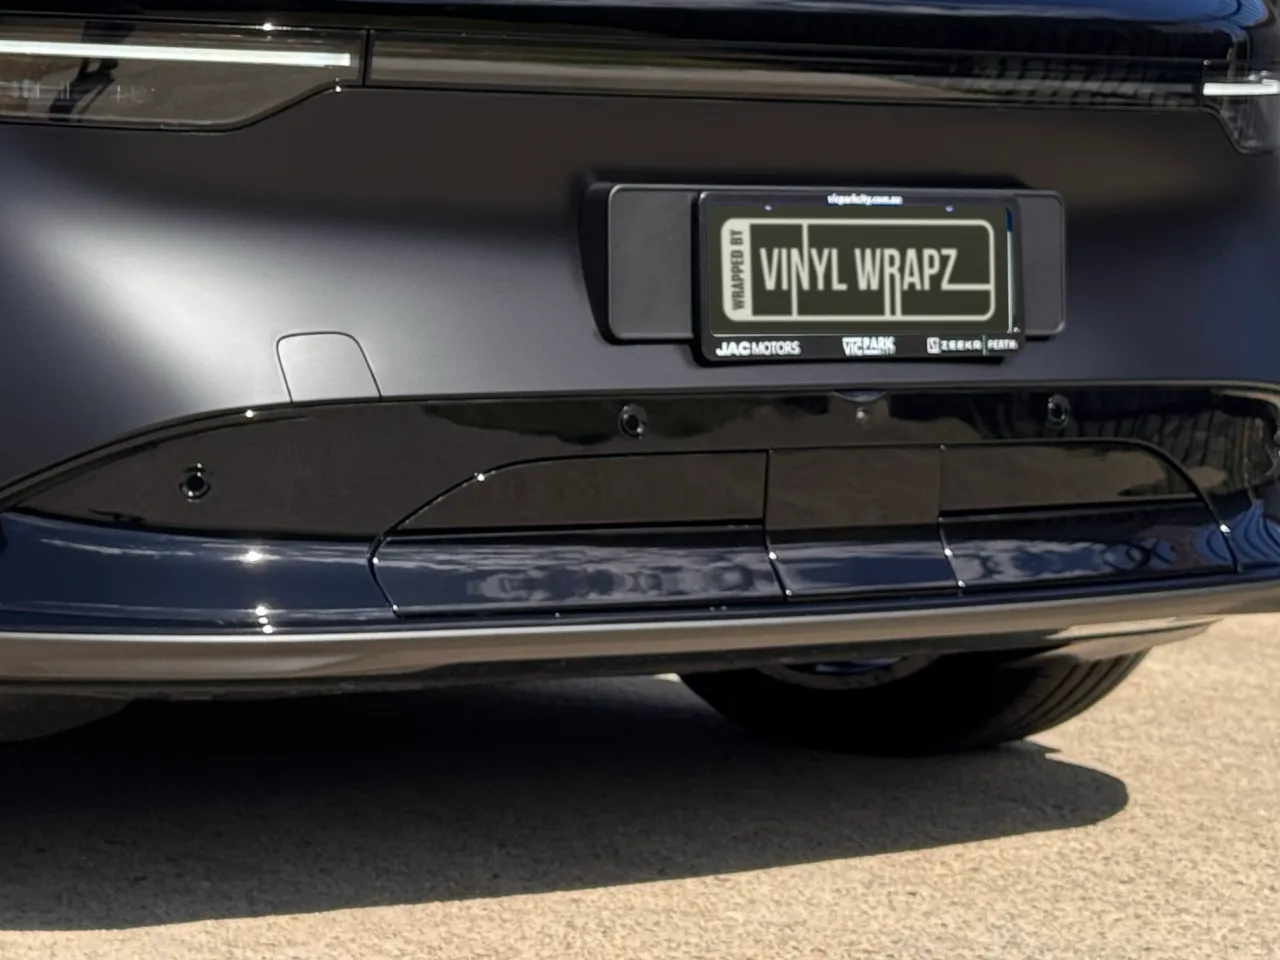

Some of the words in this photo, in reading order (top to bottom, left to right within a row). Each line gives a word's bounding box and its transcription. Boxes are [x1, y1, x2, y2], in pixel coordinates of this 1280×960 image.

[730, 228, 744, 246] BY
[730, 249, 745, 311] WRAPPED
[759, 246, 848, 291] VINYL
[853, 246, 958, 291] WRAPZ
[715, 341, 751, 357] JAC
[751, 340, 802, 356] MOTORS
